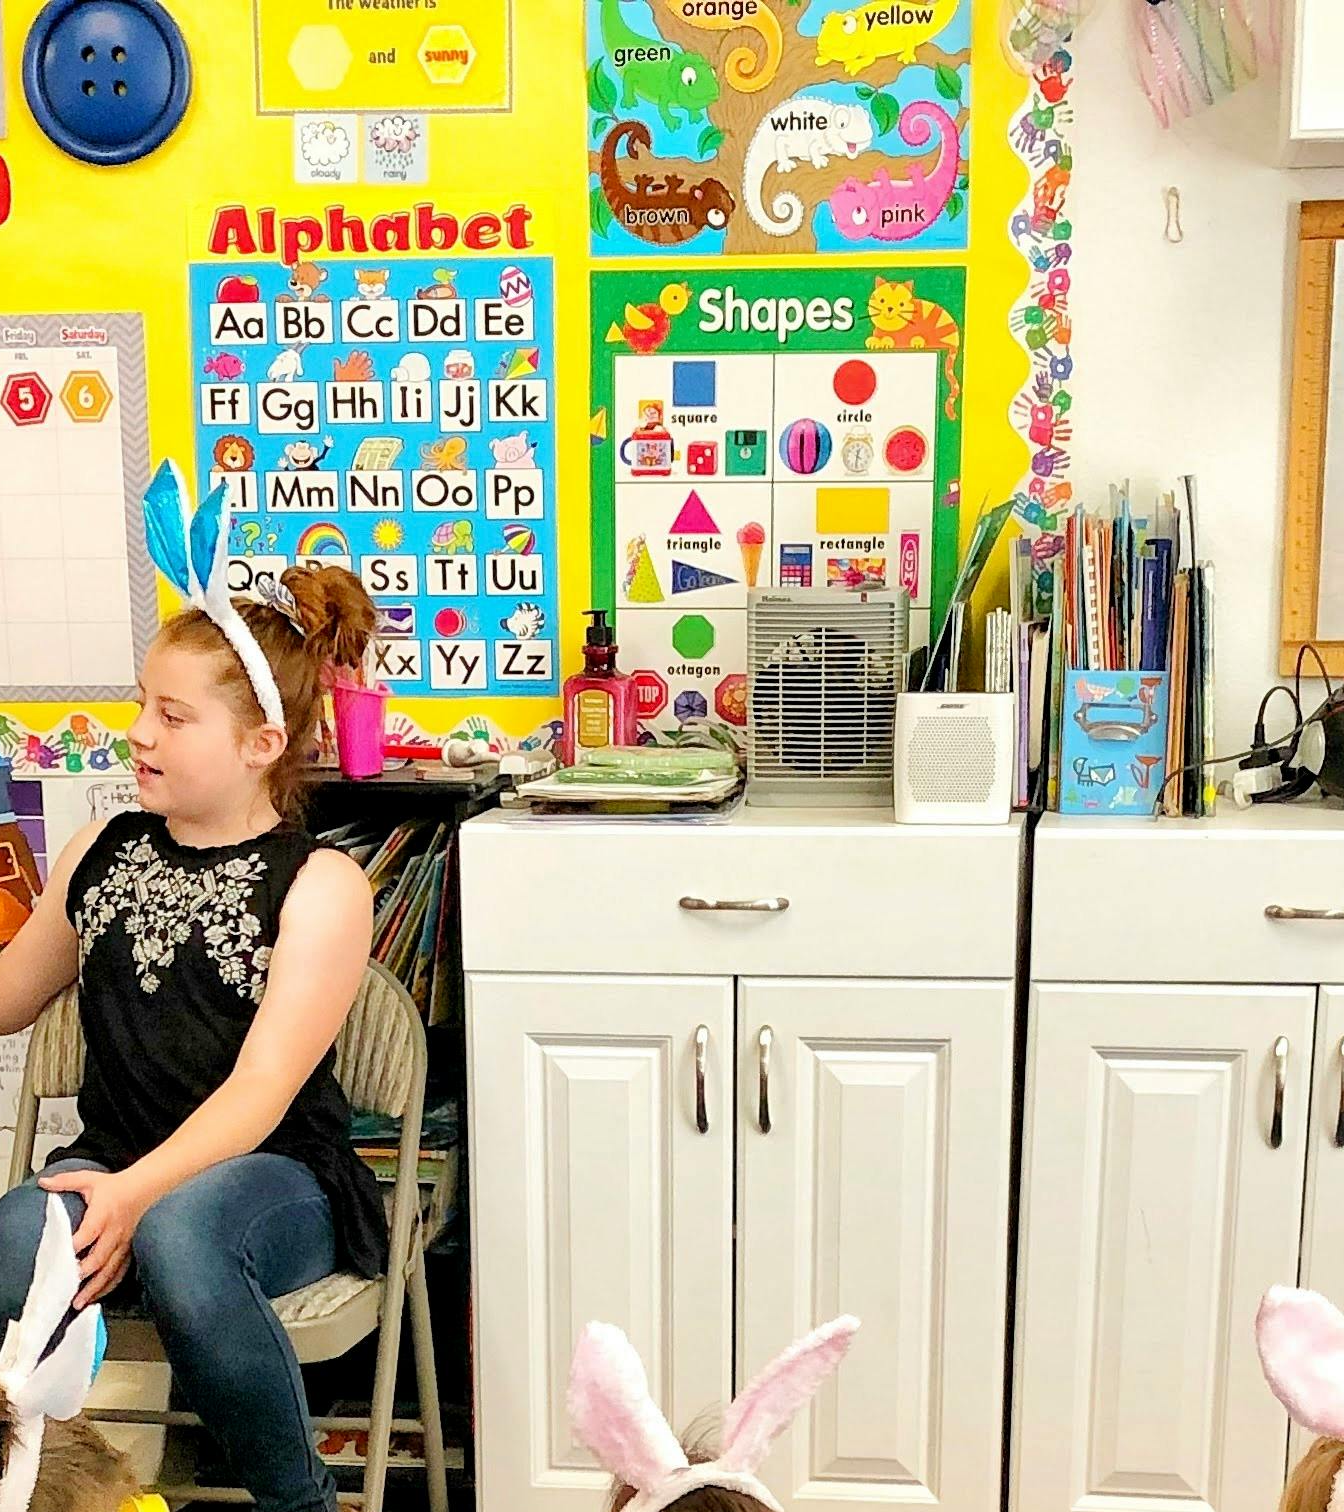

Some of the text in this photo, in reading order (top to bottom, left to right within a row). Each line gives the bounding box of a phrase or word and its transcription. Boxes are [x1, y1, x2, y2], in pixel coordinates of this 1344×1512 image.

[682, 0, 933, 30] orange yellow
[369, 48, 469, 65] and sunny
[614, 45, 671, 65] green
[771, 112, 828, 132] white
[384, 170, 407, 180] rainy
[624, 205, 925, 228] brown pink
[208, 202, 534, 266] Alphabet
[215, 304, 524, 339] Aa Bb Cc Dd Ee
[698, 286, 854, 344] Shapes
[5, 329, 34, 344] Friday
[62, 329, 105, 343] Saturday
[18, 388, 34, 411] 5
[78, 386, 94, 408] 6
[210, 385, 539, 430] Ff Gg Hh Ii Jj Kk
[671, 410, 872, 426] square circle
[272, 475, 534, 515] Mm Nn Oo Pp
[667, 537, 885, 553] triangle rectangle
[371, 560, 410, 592] Ss
[435, 559, 468, 591] Tt
[492, 560, 537, 591] Uu
[904, 550, 914, 581] GUM
[375, 644, 546, 685] Xx Yy Zz
[668, 665, 720, 678] octagon
[638, 686, 659, 703] TOP
